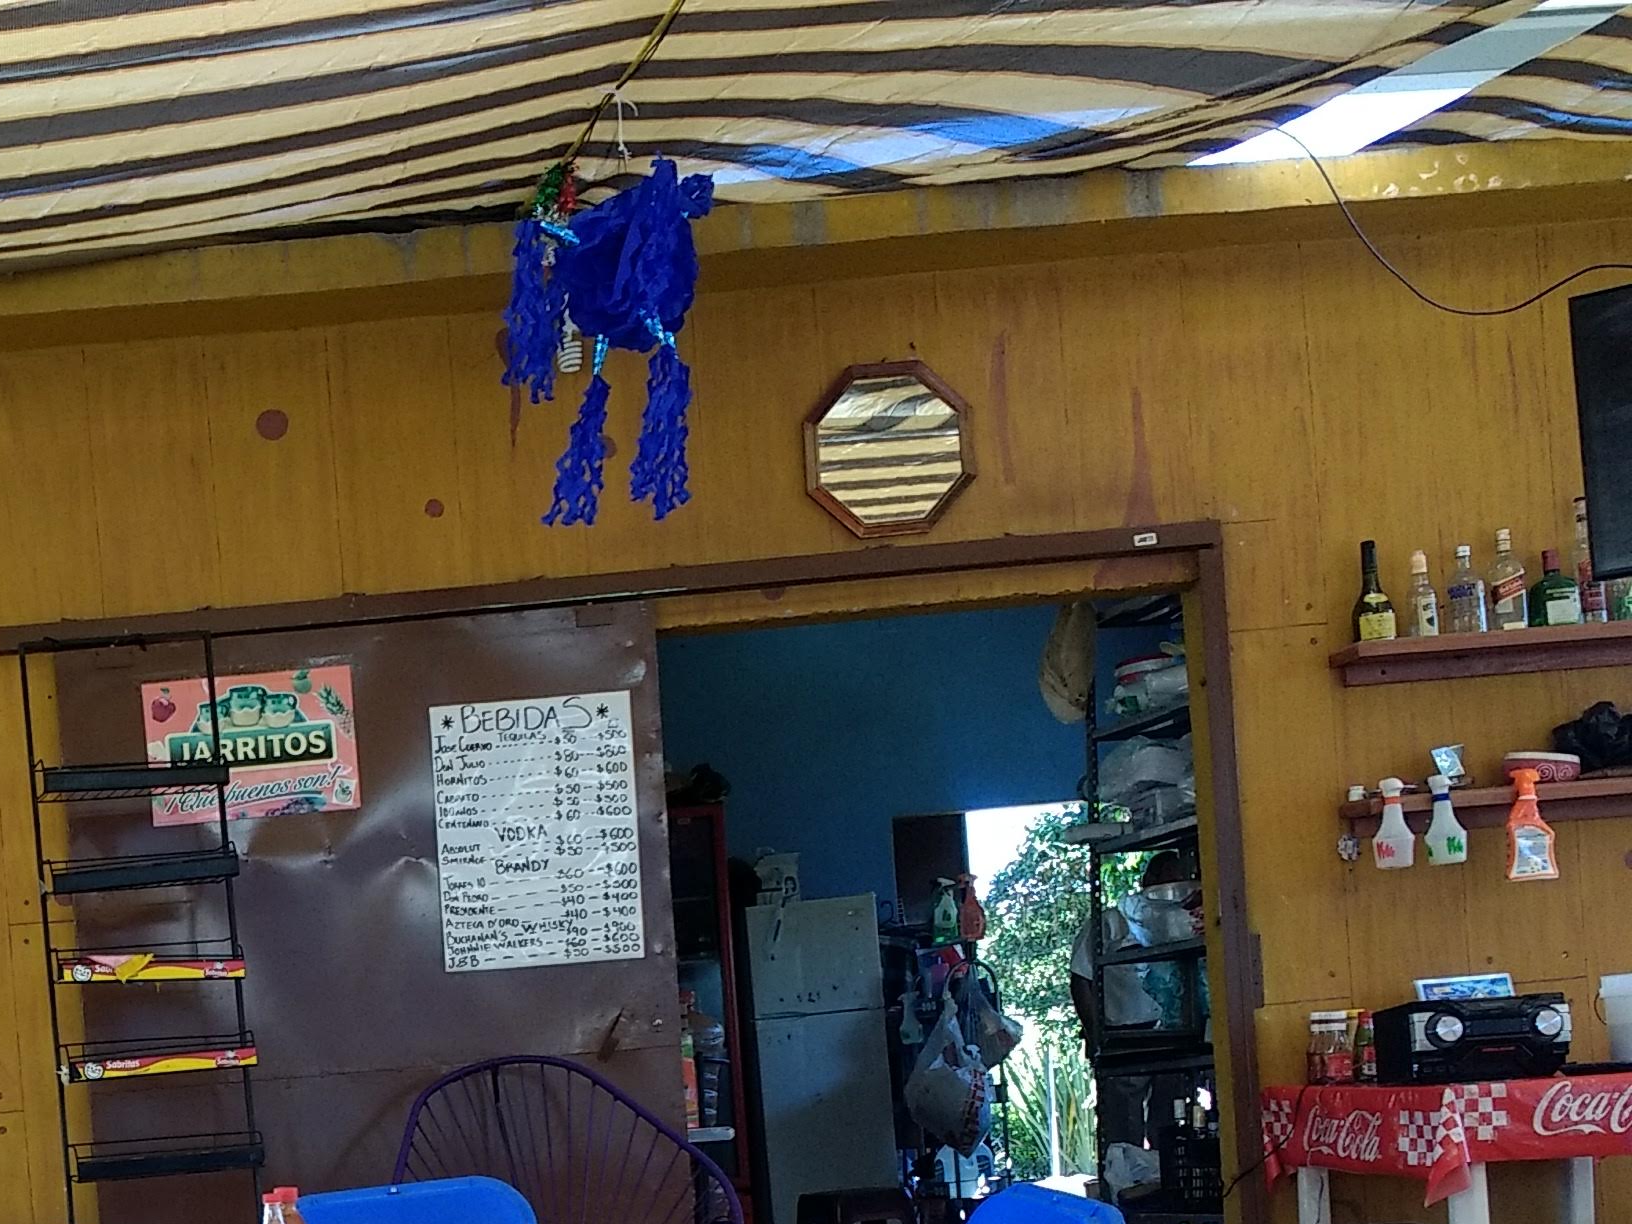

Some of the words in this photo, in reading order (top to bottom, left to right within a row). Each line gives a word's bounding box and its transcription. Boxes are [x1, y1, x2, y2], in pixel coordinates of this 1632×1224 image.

[460, 696, 593, 734] BEBIDAS
[596, 761, 628, 775] $600
[224, 779, 290, 803] buenos
[293, 765, 341, 788] son!
[596, 780, 628, 791] $500
[596, 805, 632, 816] $600
[494, 824, 548, 842] VODKA
[599, 827, 634, 840] $600
[495, 857, 550, 875] BRANDY
[602, 892, 638, 903] $400
[446, 918, 485, 930] AZTECA
[521, 919, 573, 933] WHISKY
[446, 929, 509, 946] BUCHANAN'S
[105, 1059, 140, 1070] Sabritas
